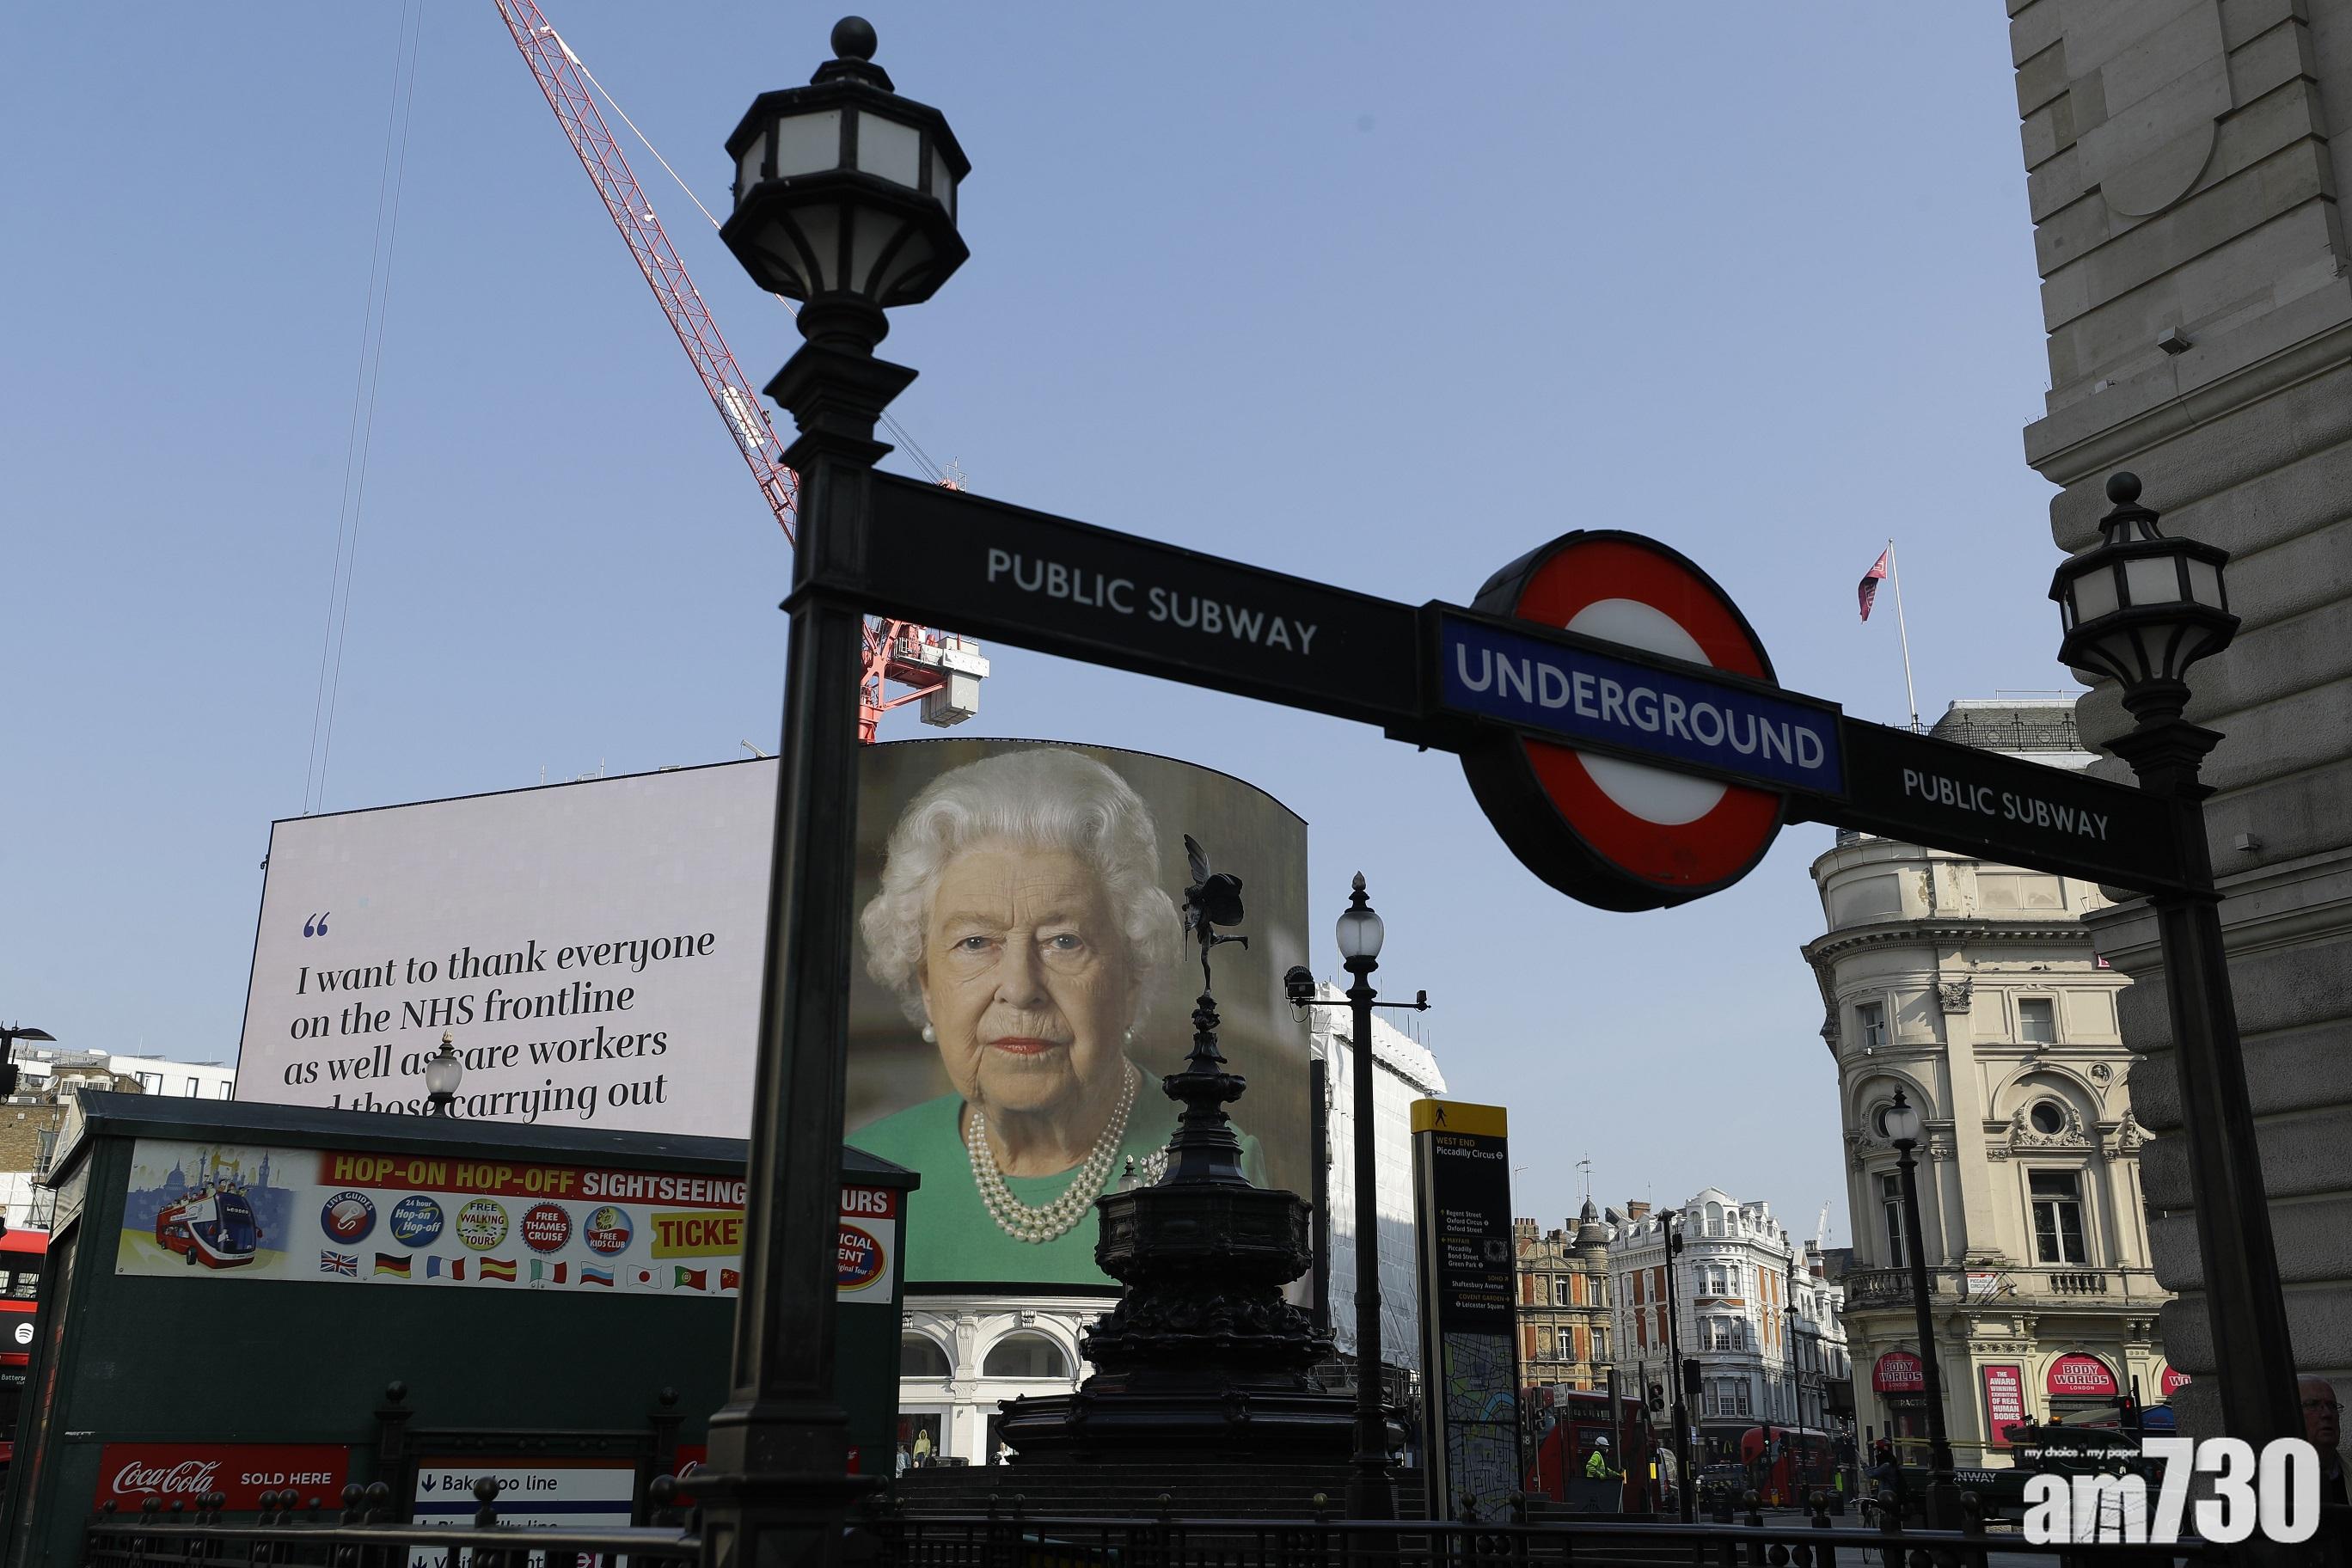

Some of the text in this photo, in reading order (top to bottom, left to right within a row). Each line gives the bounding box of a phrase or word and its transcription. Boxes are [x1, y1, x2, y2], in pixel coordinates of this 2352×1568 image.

[988, 548, 1318, 655] PUBLIC SUBWAY
[1455, 641, 1825, 770] UNDERGROUND
[1903, 768, 2109, 842] PUBLIC SUBWAY
[296, 931, 715, 995] I want to thank everyone
[290, 980, 634, 1040] on the NHS frontline
[284, 1025, 668, 1086] as well as care workers
[449, 1078, 598, 1124] carrying
[608, 1074, 668, 1107] out
[1436, 1136, 1475, 1147] WEST END
[1436, 1146, 1495, 1159] Piccadilly Circus
[334, 1155, 888, 1214] HOP-ON HOP-OFF SIGHTSEEING URS
[326, 1191, 373, 1210] LIVE GUIDES
[469, 1202, 498, 1213] FREE
[395, 1208, 431, 1220] Hop-on
[460, 1213, 505, 1225] WALKING
[536, 1211, 559, 1222] FREE
[1446, 1210, 1465, 1218] Regent
[402, 1221, 440, 1233] Hop-off
[525, 1222, 567, 1232] THAMES
[465, 1235, 496, 1246] TOURS
[527, 1231, 563, 1242] CRUISE
[599, 1232, 617, 1240] FREE
[838, 1232, 873, 1250] ICIAL
[1447, 1245, 1473, 1253] Piccadilly
[838, 1248, 865, 1263] ENT
[837, 1263, 854, 1272] iginal
[1452, 1280, 1484, 1289] Shaftesbury
[1883, 1362, 1914, 1372] BODY
[2061, 1363, 2100, 1375] BODY
[1878, 1372, 1923, 1381] WORLDS
[2053, 1375, 2110, 1385] WORLDS
[112, 1461, 332, 1494] Coca-Cola SOLD HERE
[442, 1474, 558, 1491] Bakoo line
[1957, 1471, 1996, 1483] NWAY
